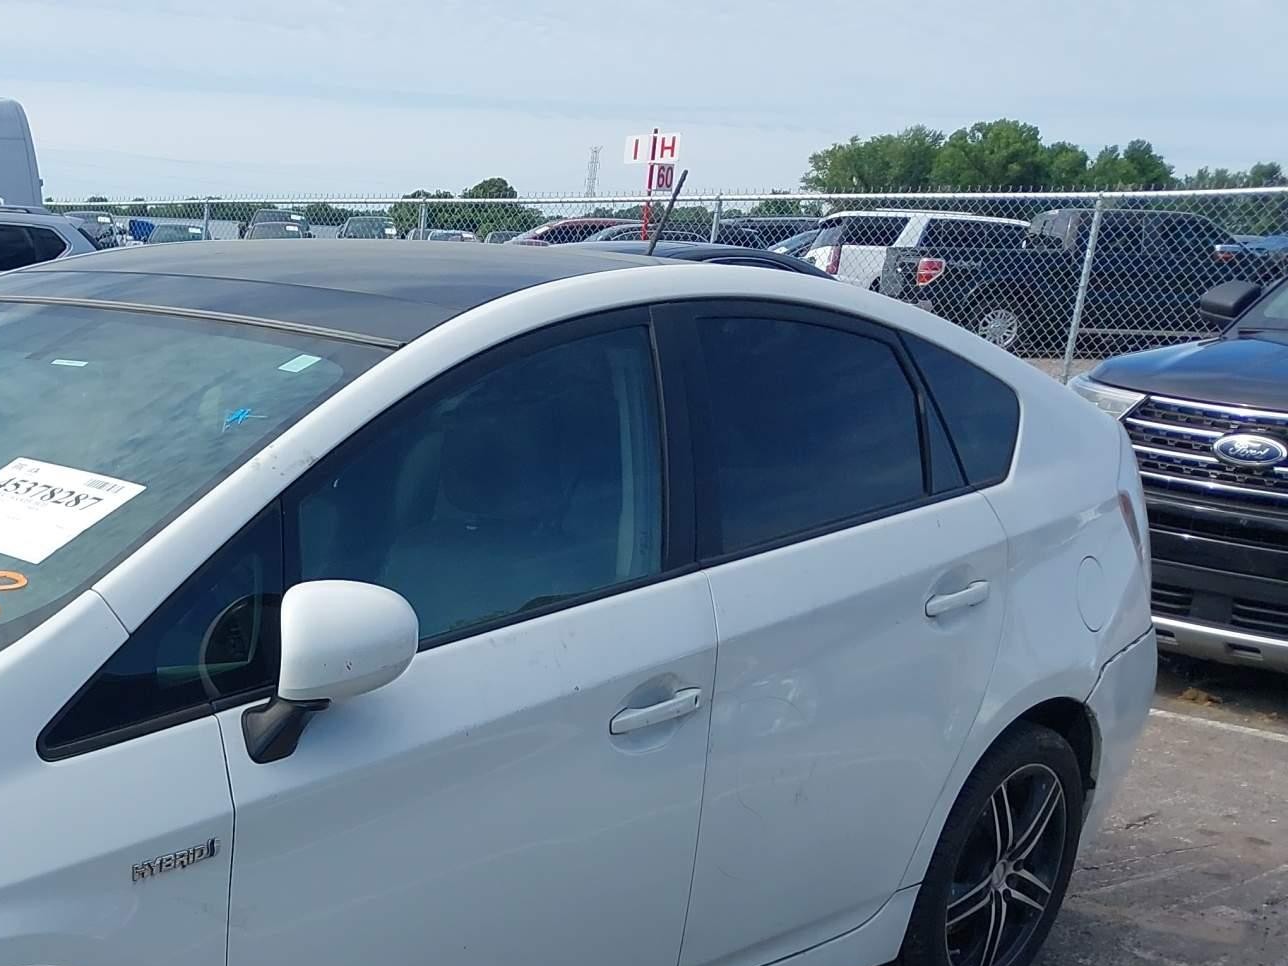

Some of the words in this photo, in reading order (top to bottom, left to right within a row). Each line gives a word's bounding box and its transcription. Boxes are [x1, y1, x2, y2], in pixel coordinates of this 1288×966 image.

[660, 135, 676, 158] H
[657, 165, 674, 188] 60
[1228, 440, 1270, 457] Ford
[132, 844, 208, 881] HYBRID
